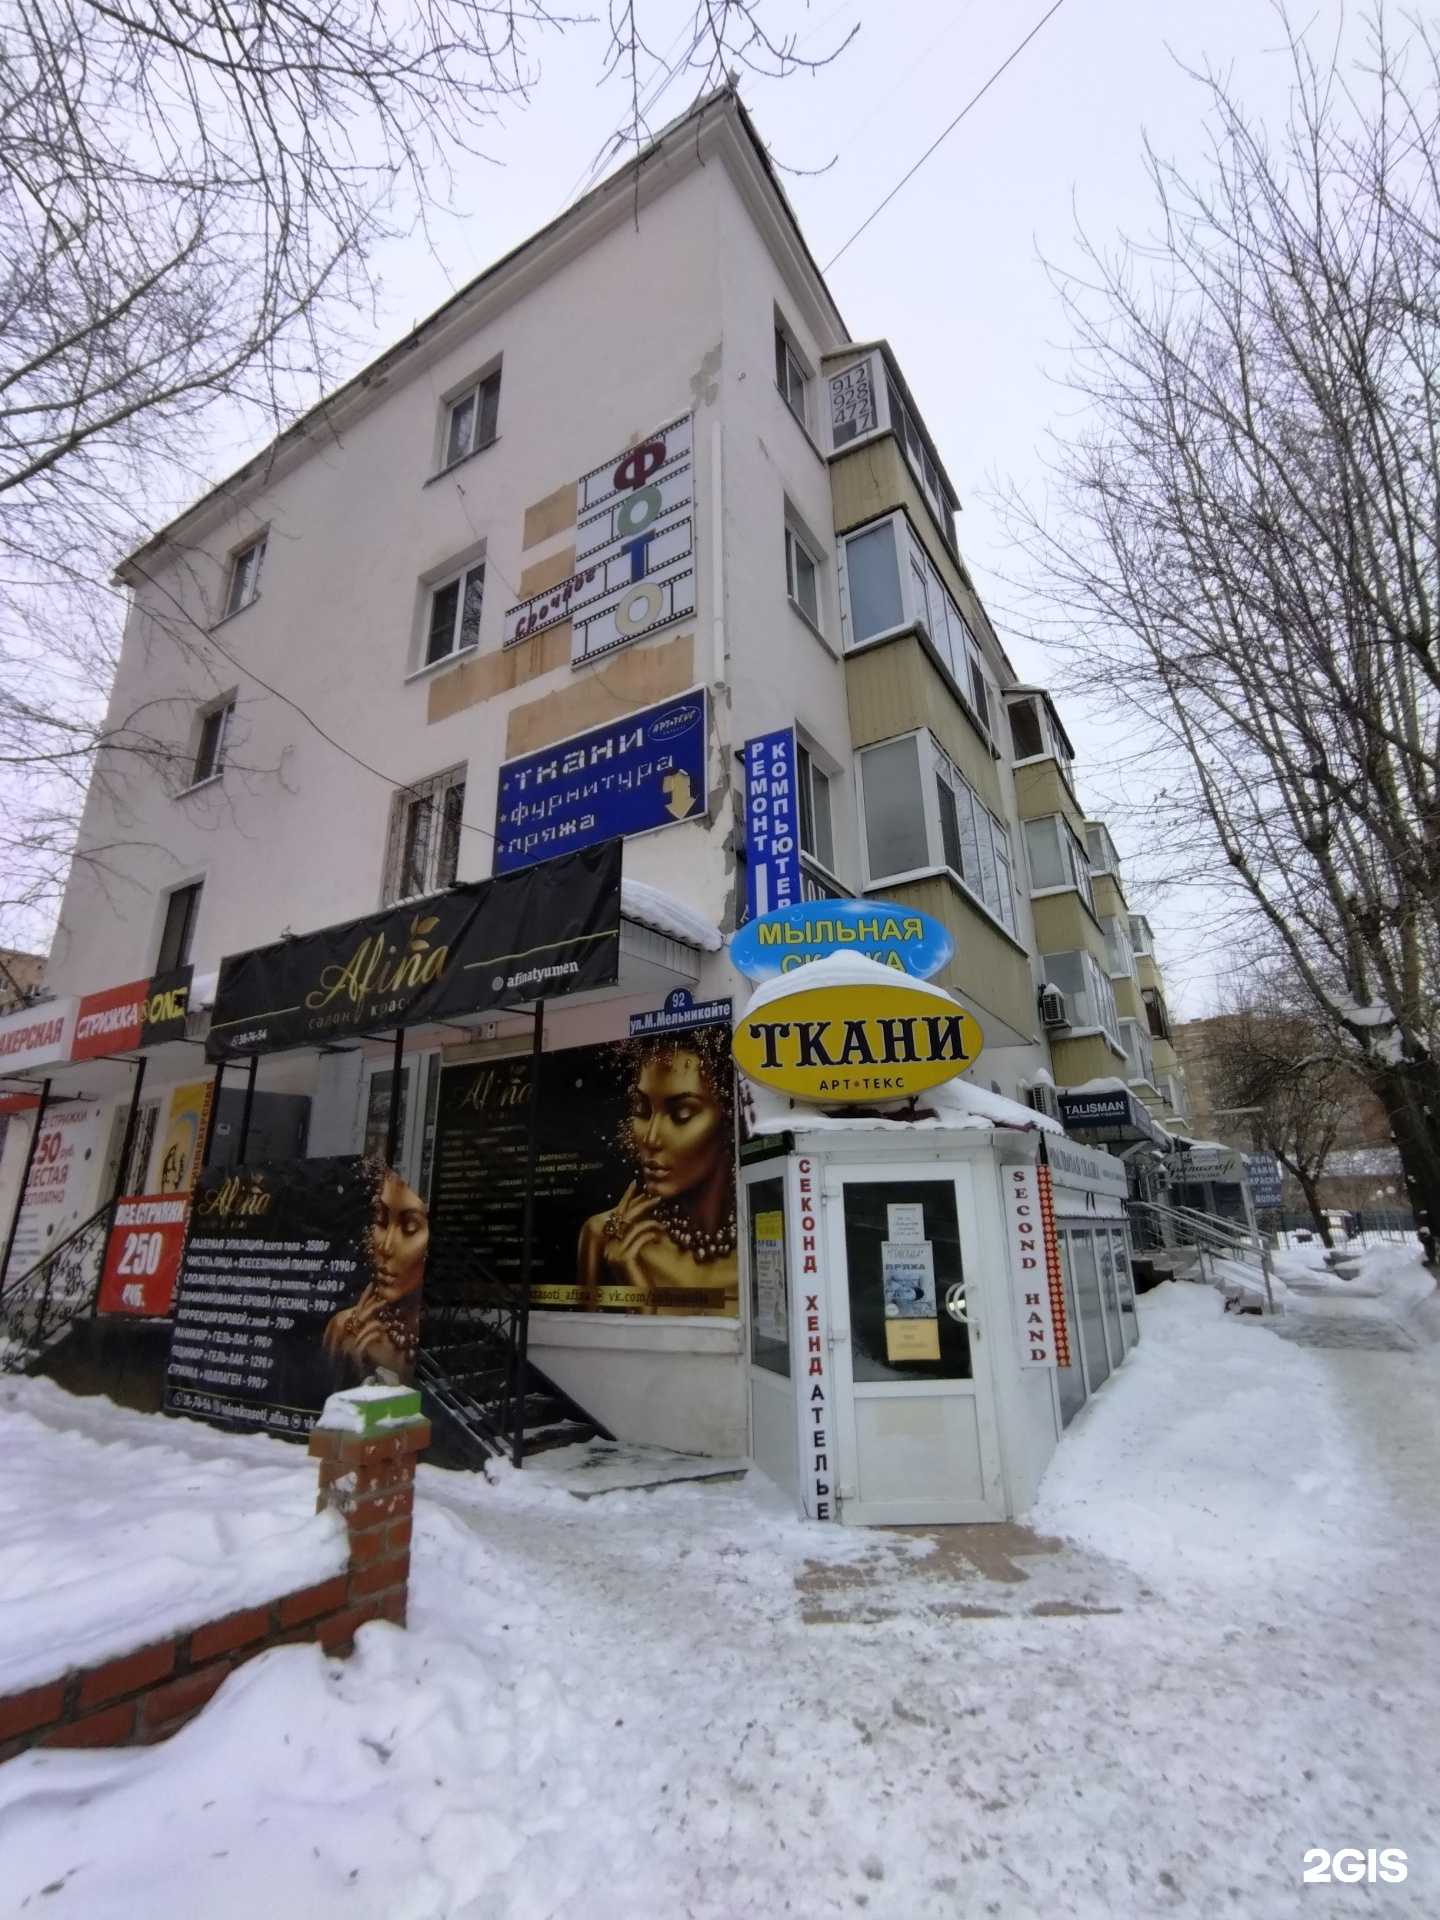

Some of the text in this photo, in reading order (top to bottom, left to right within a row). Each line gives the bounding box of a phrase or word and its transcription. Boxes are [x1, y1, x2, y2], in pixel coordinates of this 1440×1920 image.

[613, 440, 667, 637] ФОТО
[751, 742, 768, 851] РЕМОНТ
[758, 918, 924, 945] МЫЛЬНАЯ
[77, 1002, 138, 1040] СТРИЖКА
[672, 991, 686, 1008] 92
[749, 1015, 970, 1069] ТКАНИ
[1064, 1101, 1125, 1115] TALISMAN
[33, 1132, 62, 1165] 50
[117, 1232, 163, 1275] 250
[799, 1159, 824, 1376] СЕКОНД ХЕНД
[1013, 1171, 1046, 1361] SECOND HAND
[810, 1384, 830, 1521] АТЕЛЬЕ
